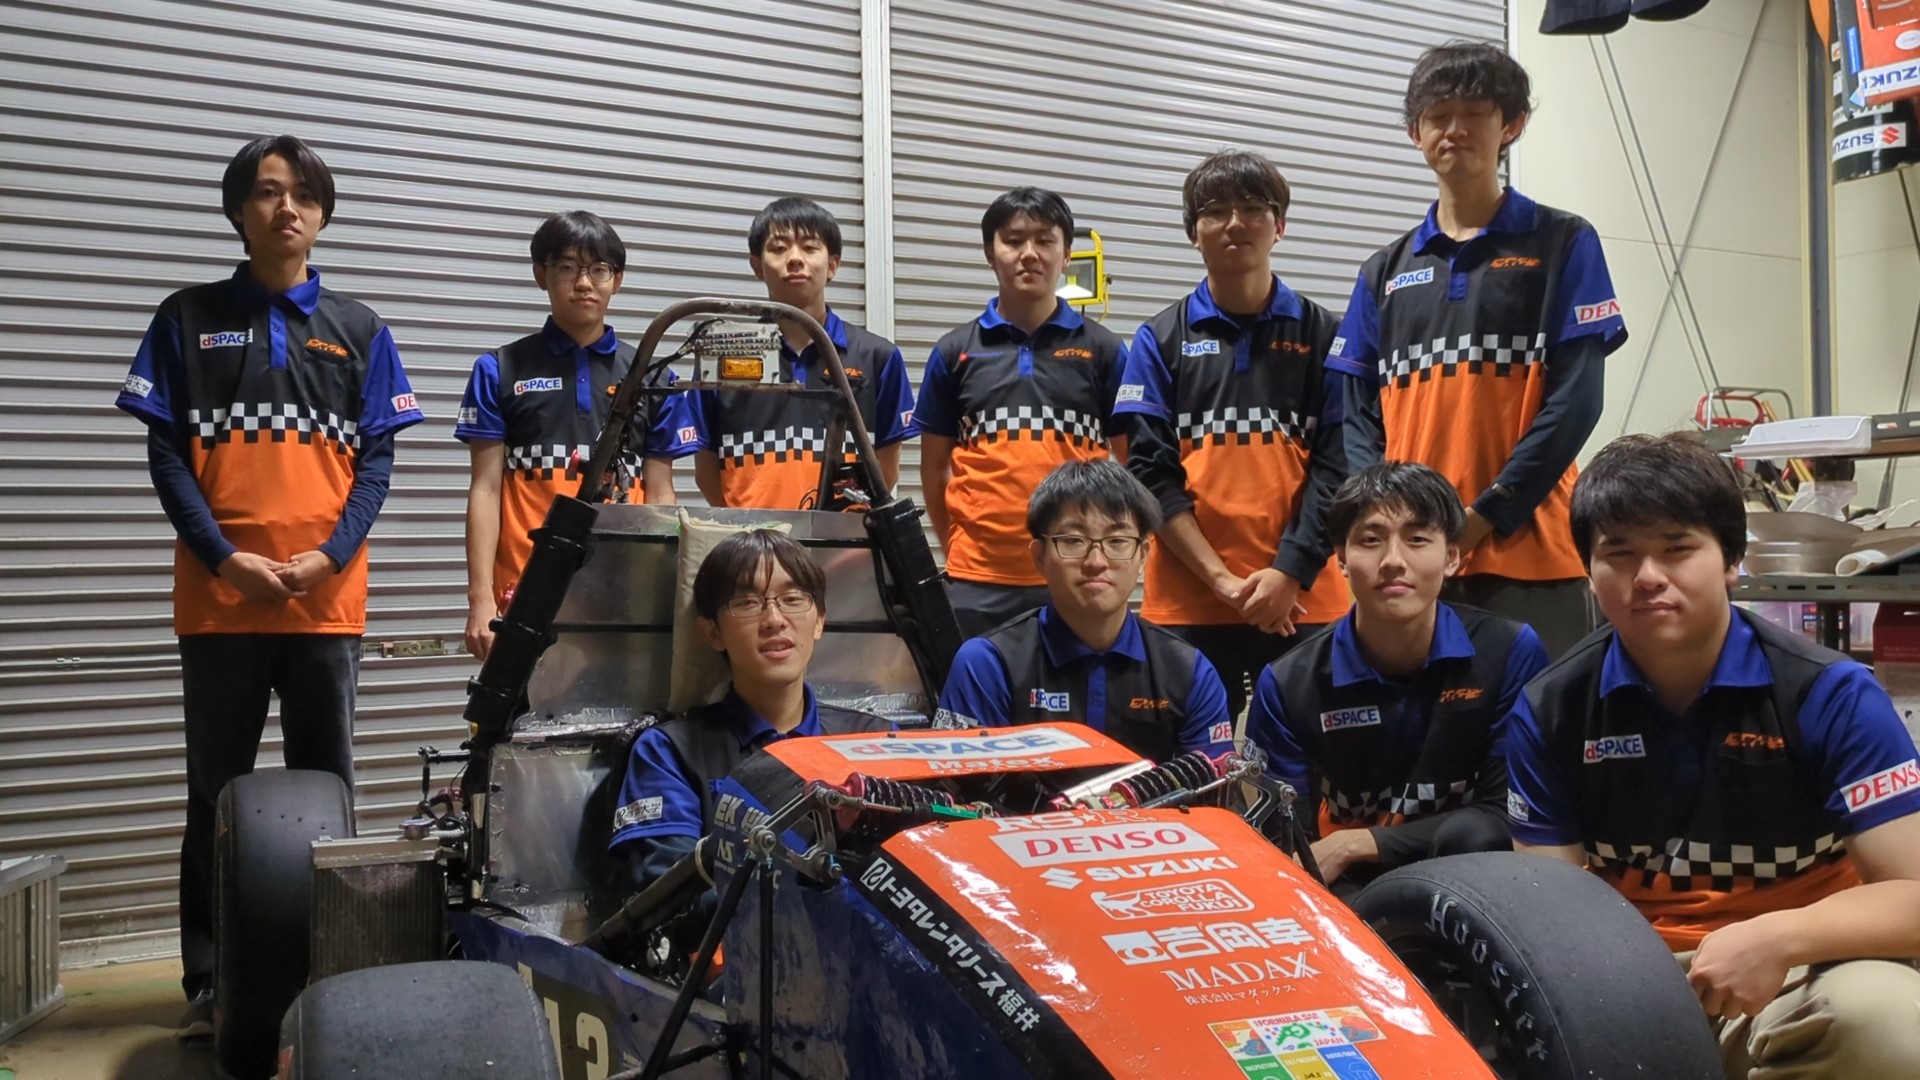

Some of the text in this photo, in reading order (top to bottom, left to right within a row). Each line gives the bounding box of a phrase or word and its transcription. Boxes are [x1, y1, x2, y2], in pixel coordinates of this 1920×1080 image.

[516, 379, 561, 393] dSPACE
[1324, 708, 1377, 729] dSPACE
[849, 732, 1057, 755] dSPACE
[1585, 736, 1642, 761] dSPACE
[1024, 829, 1188, 858] DENSO
[1085, 856, 1239, 883] SUZUKI
[1140, 891, 1234, 908] COROLLA
[1144, 883, 1224, 899] TOYOTA
[1177, 899, 1244, 911] FUKUI
[1152, 918, 1315, 959] 吉岡幸
[879, 876, 1040, 1032] トヨタレンタリース福井
[1258, 1014, 1300, 1027] FORMULA
[1314, 1037, 1345, 1046] JAPAN
